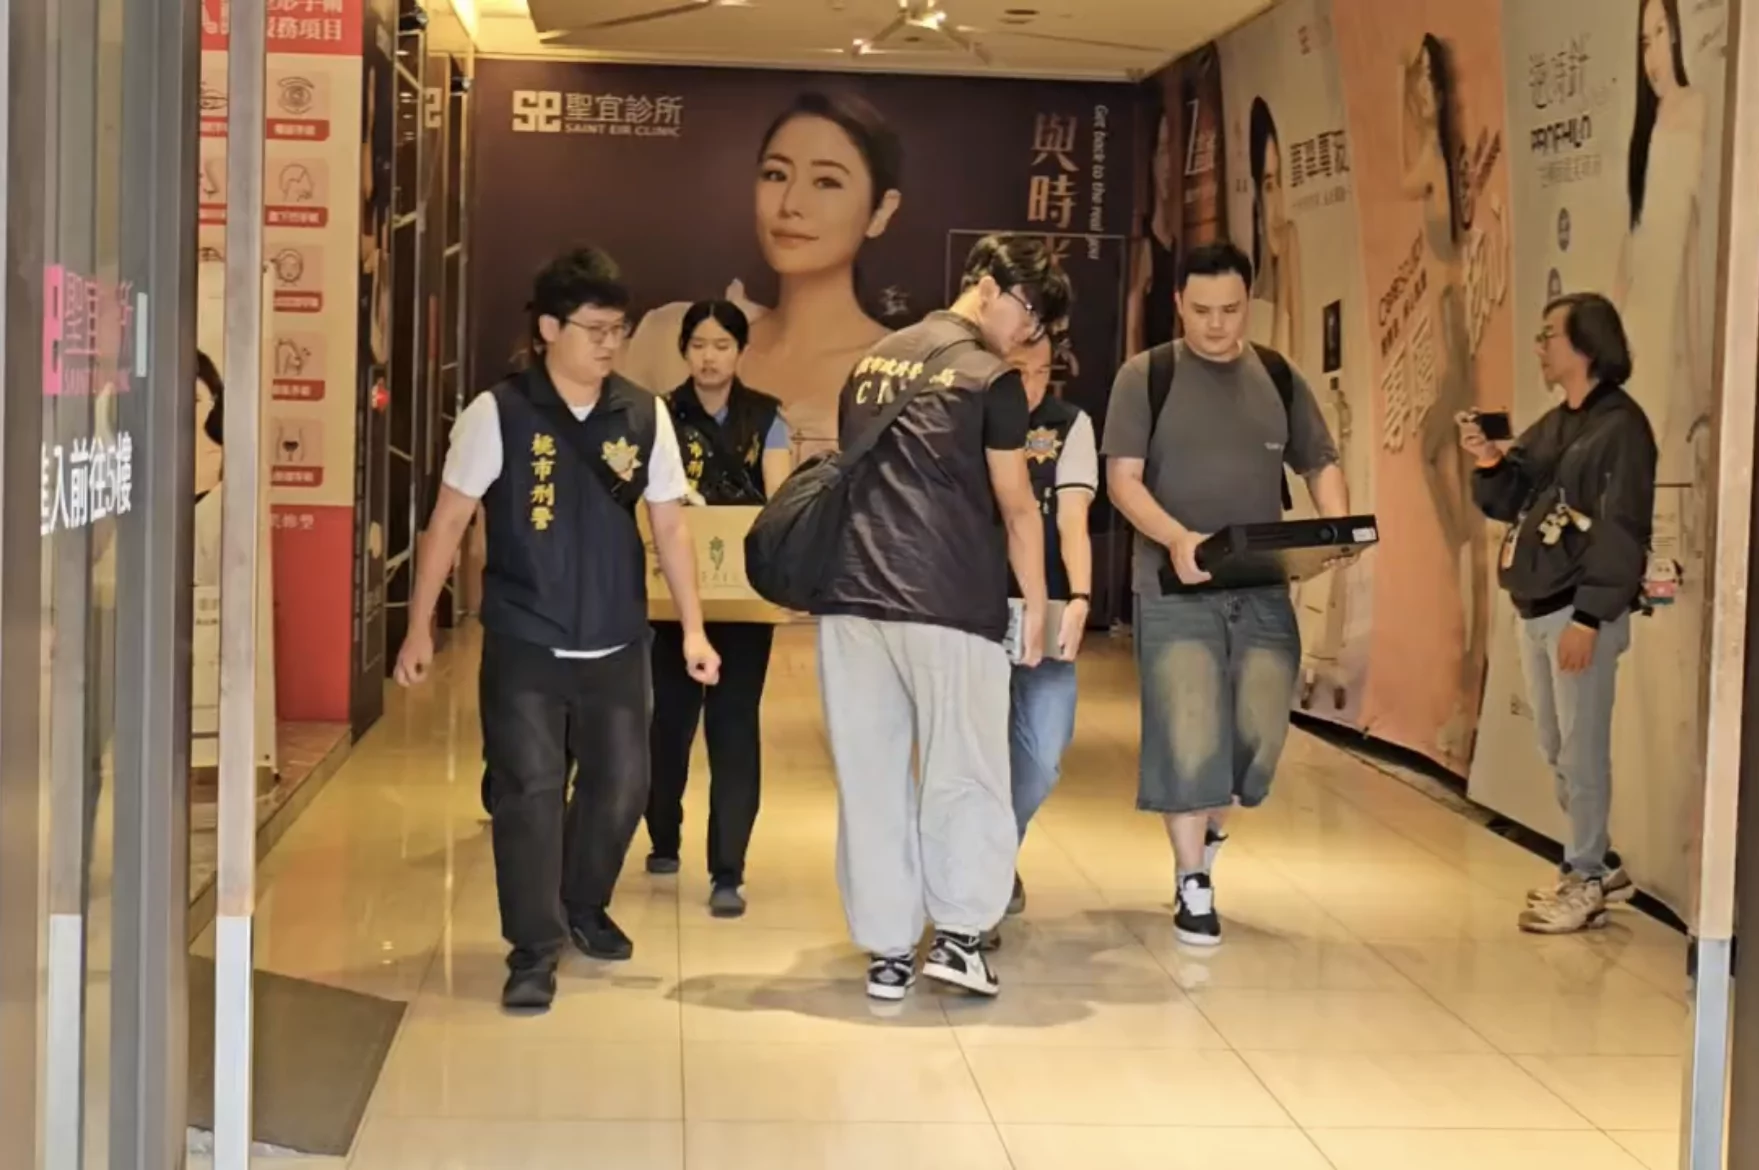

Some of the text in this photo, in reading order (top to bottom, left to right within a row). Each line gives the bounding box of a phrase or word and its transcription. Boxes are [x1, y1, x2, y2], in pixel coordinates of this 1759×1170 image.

[565, 93, 684, 125] 聖宜診所
[565, 123, 604, 134] SAINT
[634, 126, 681, 137] CLINIC
[1092, 130, 1107, 163] back
[1091, 164, 1106, 179] to
[1091, 182, 1105, 204] the
